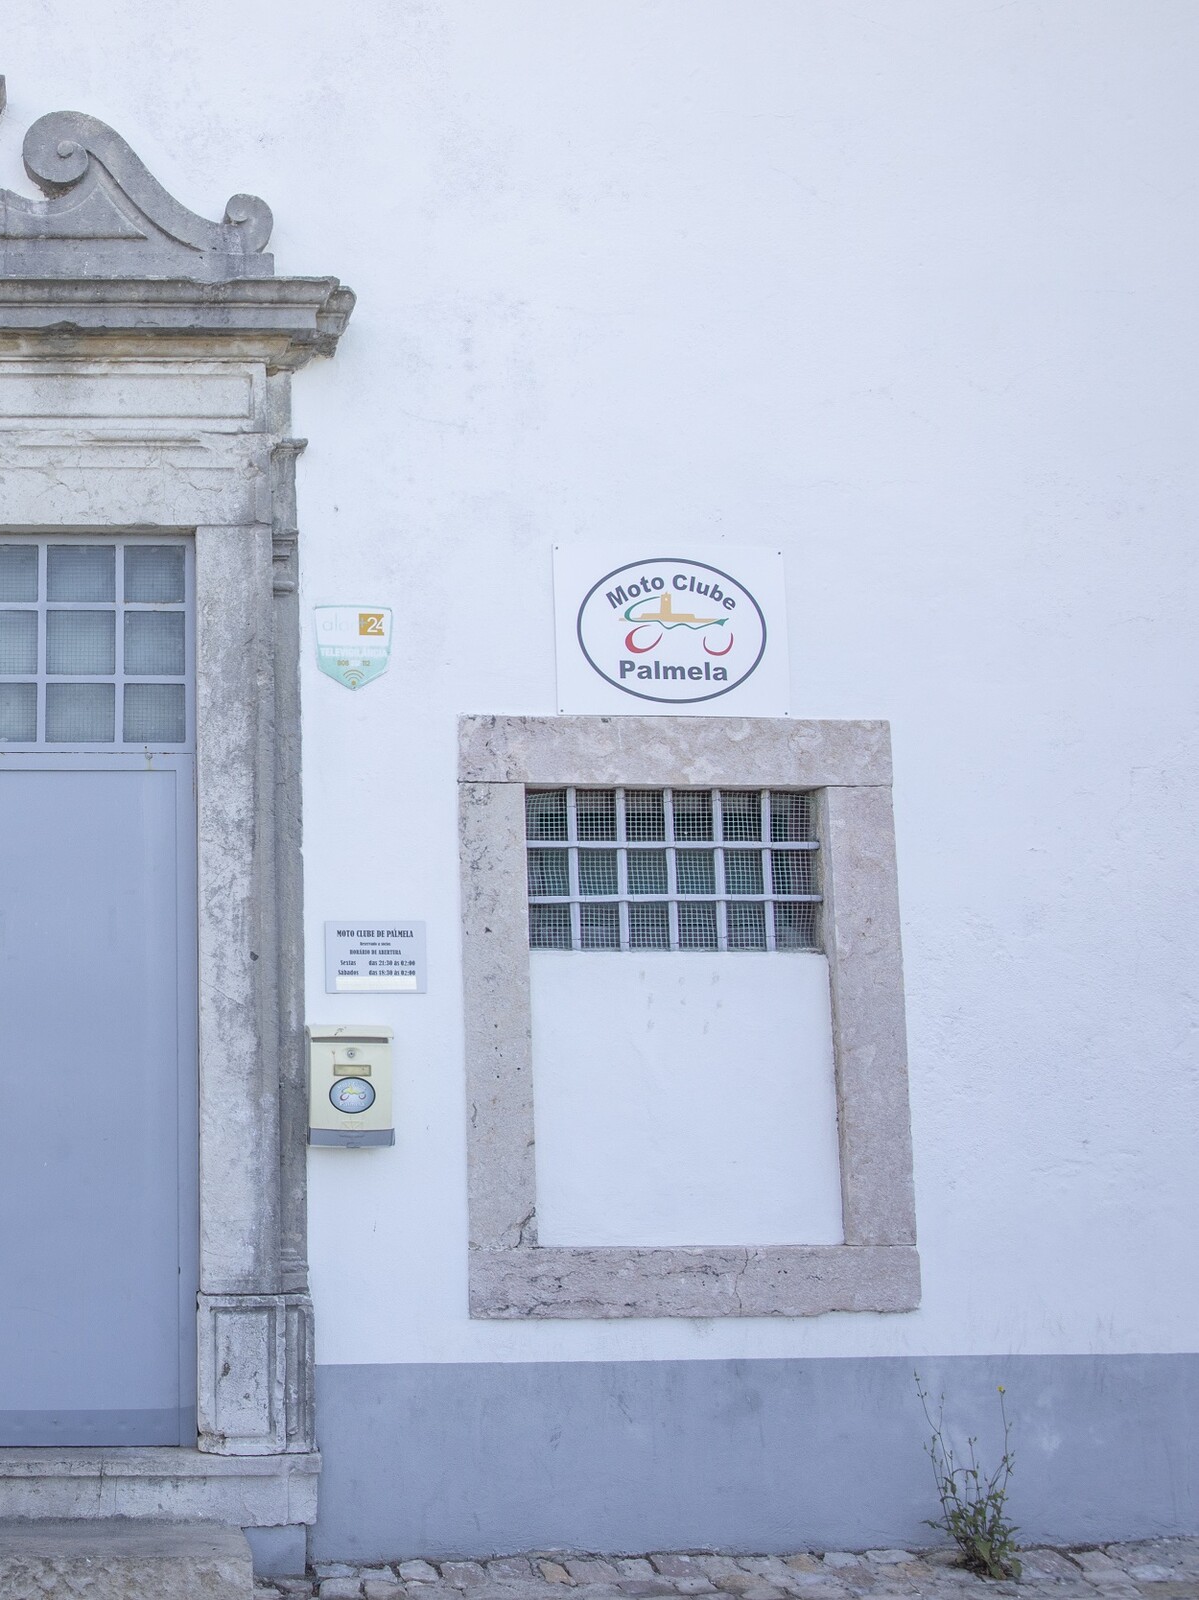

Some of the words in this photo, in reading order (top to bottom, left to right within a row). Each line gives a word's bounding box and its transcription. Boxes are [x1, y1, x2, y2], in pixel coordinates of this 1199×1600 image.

[605, 575, 665, 609] Moto
[672, 574, 736, 611] Clube
[619, 660, 728, 681] Palmela
[336, 930, 355, 938] MOTO
[356, 930, 375, 938] CLUBE
[376, 930, 385, 938] DE
